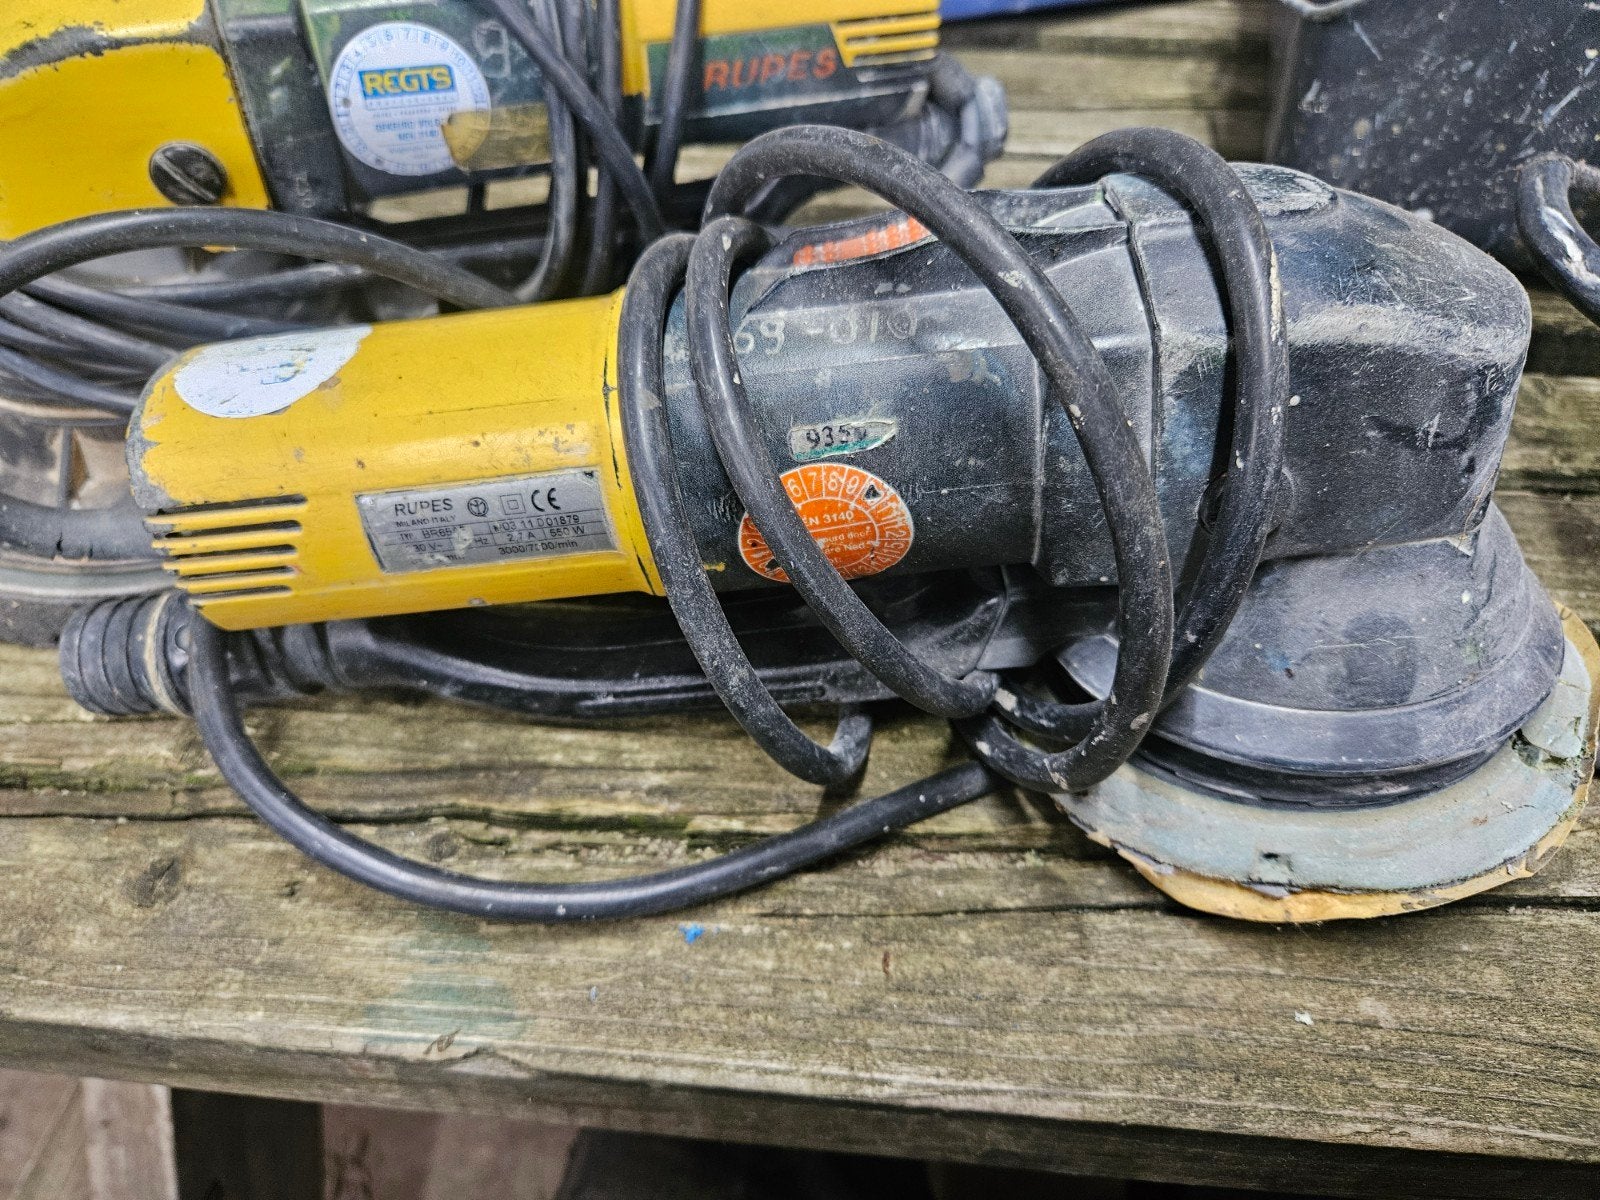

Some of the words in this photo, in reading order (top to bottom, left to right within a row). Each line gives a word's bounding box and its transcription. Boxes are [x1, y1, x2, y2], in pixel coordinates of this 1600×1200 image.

[703, 48, 839, 92] RUPES
[363, 66, 452, 96] REGTS
[787, 478, 802, 498] 6
[808, 471, 818, 493] 7
[828, 472, 840, 492] 8
[846, 475, 859, 495] 9
[394, 498, 454, 517] RUPES
[531, 487, 561, 512] CE
[395, 518, 430, 528] MILANO
[432, 514, 456, 524] ITALY
[823, 510, 855, 524] 3140
[528, 531, 536, 539] A
[549, 528, 571, 538] 550
[572, 525, 585, 535] W
